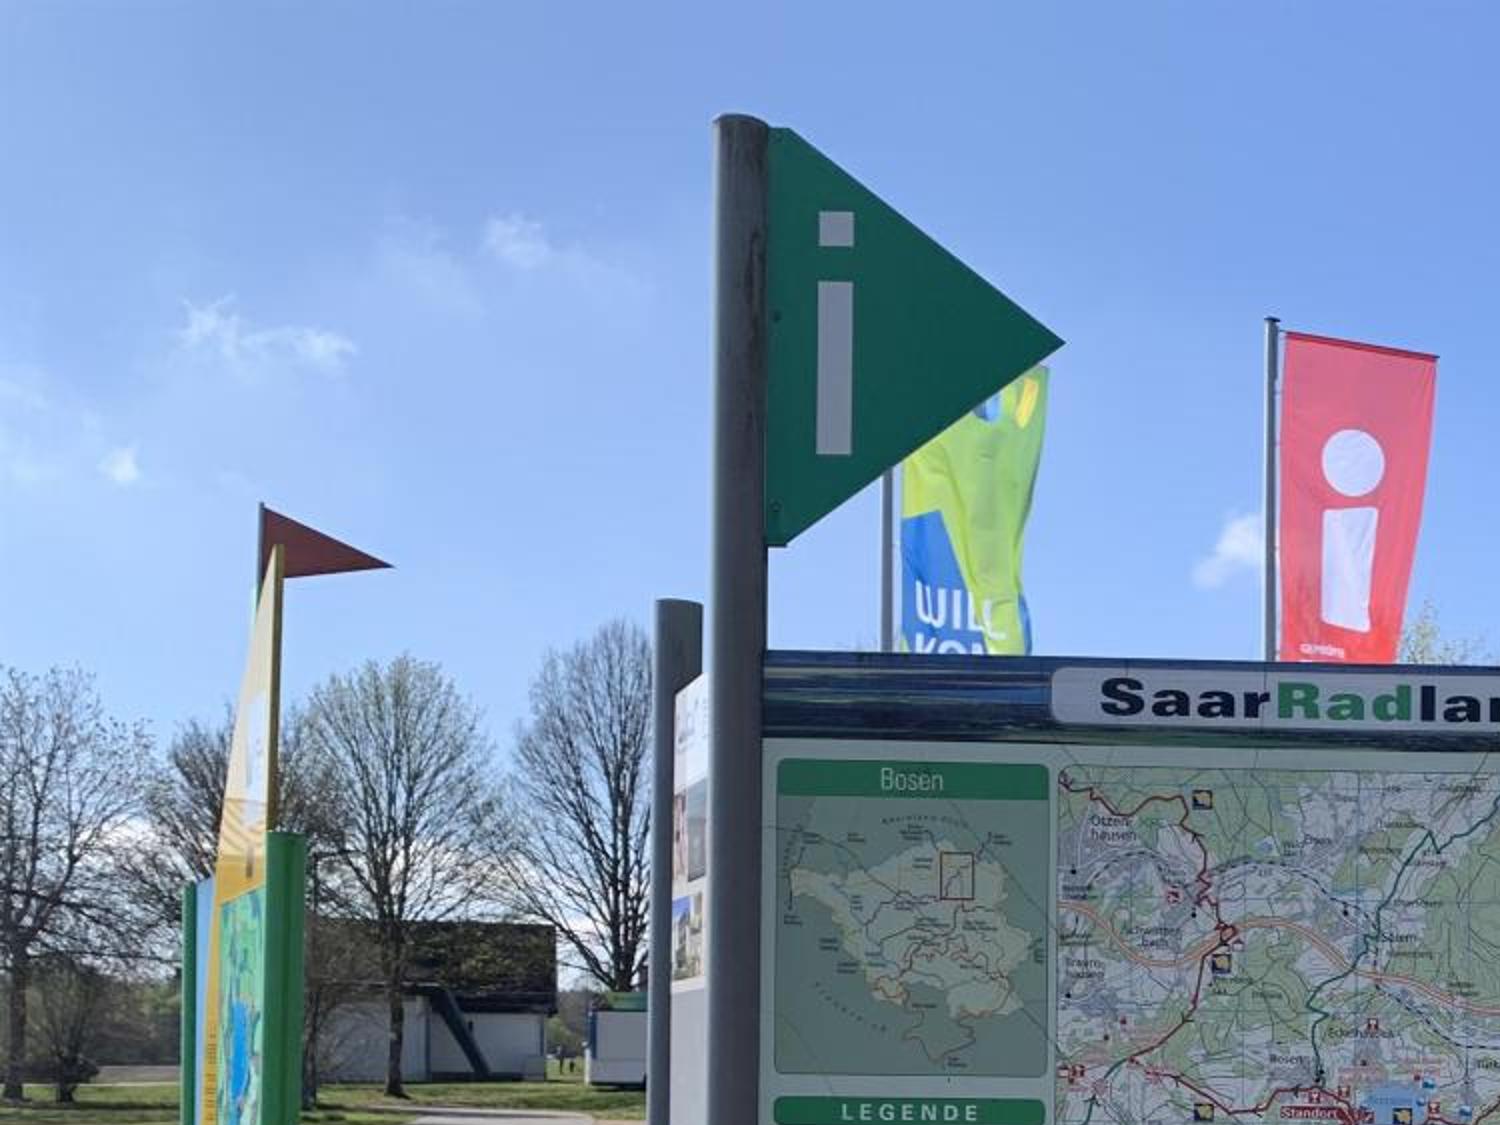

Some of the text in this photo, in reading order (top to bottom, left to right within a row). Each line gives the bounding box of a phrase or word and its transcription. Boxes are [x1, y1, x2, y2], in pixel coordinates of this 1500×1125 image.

[881, 767, 944, 792] Bosen
[1091, 828, 1137, 841] hausen
[841, 1102, 978, 1121] LEGENDE
